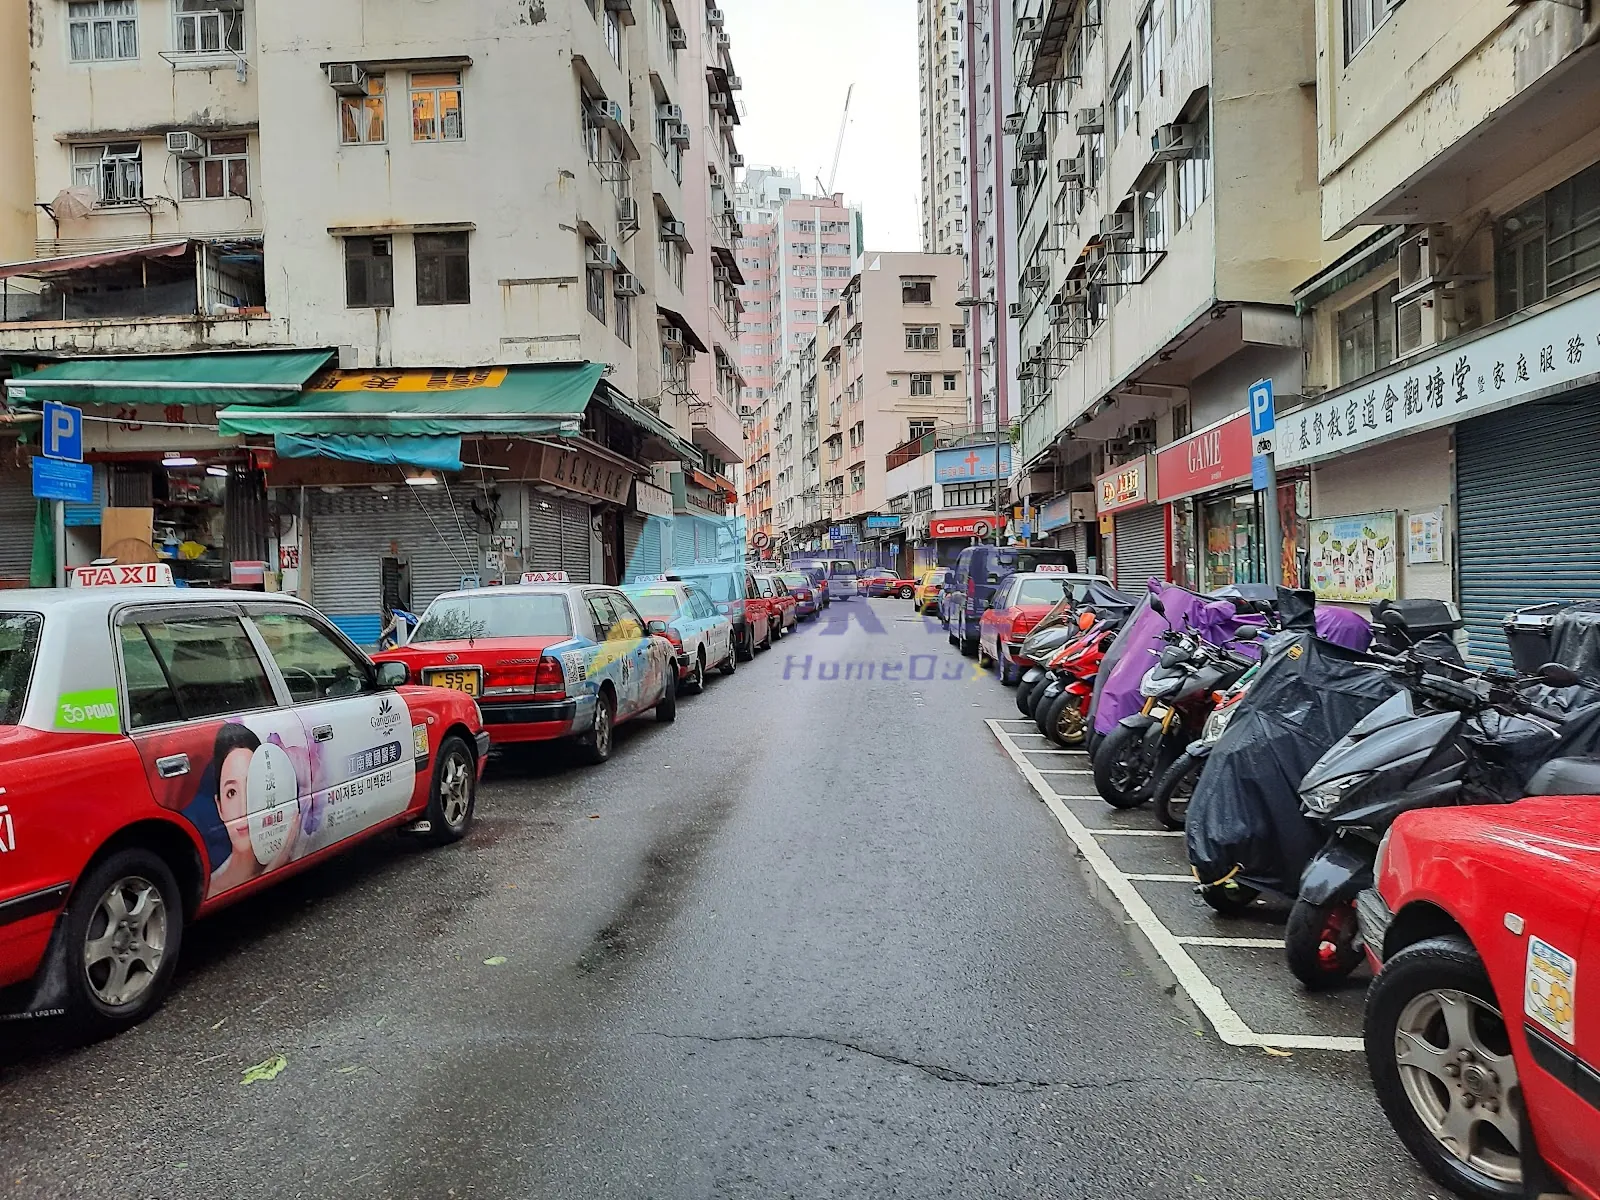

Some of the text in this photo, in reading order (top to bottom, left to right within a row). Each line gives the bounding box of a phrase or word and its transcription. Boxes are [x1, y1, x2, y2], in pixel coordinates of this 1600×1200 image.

[1253, 387, 1269, 430] P
[51, 409, 74, 452] P
[1188, 429, 1222, 473] GAME
[77, 565, 157, 586] TAXI
[525, 571, 563, 582] TAXI
[445, 673, 464, 684] SS
[370, 712, 401, 728] Gangnam
